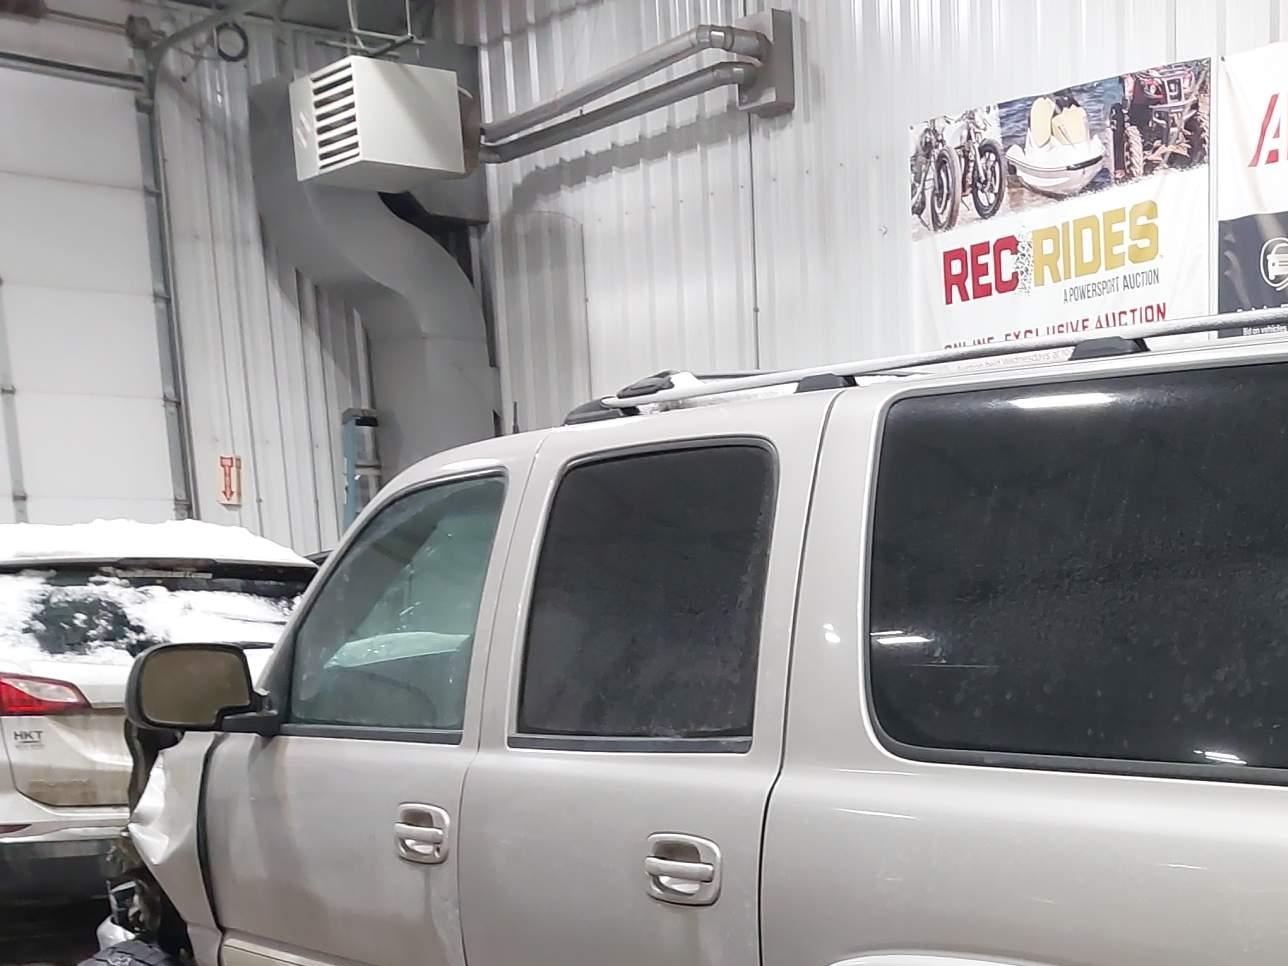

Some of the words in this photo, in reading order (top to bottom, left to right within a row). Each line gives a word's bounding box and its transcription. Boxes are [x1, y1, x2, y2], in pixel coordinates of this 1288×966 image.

[943, 234, 1020, 306] REC
[1031, 199, 1159, 288] RIDES
[1069, 276, 1120, 302] POWERSPORT
[1122, 268, 1160, 289] AUCTION
[1095, 302, 1167, 330] AUCTION
